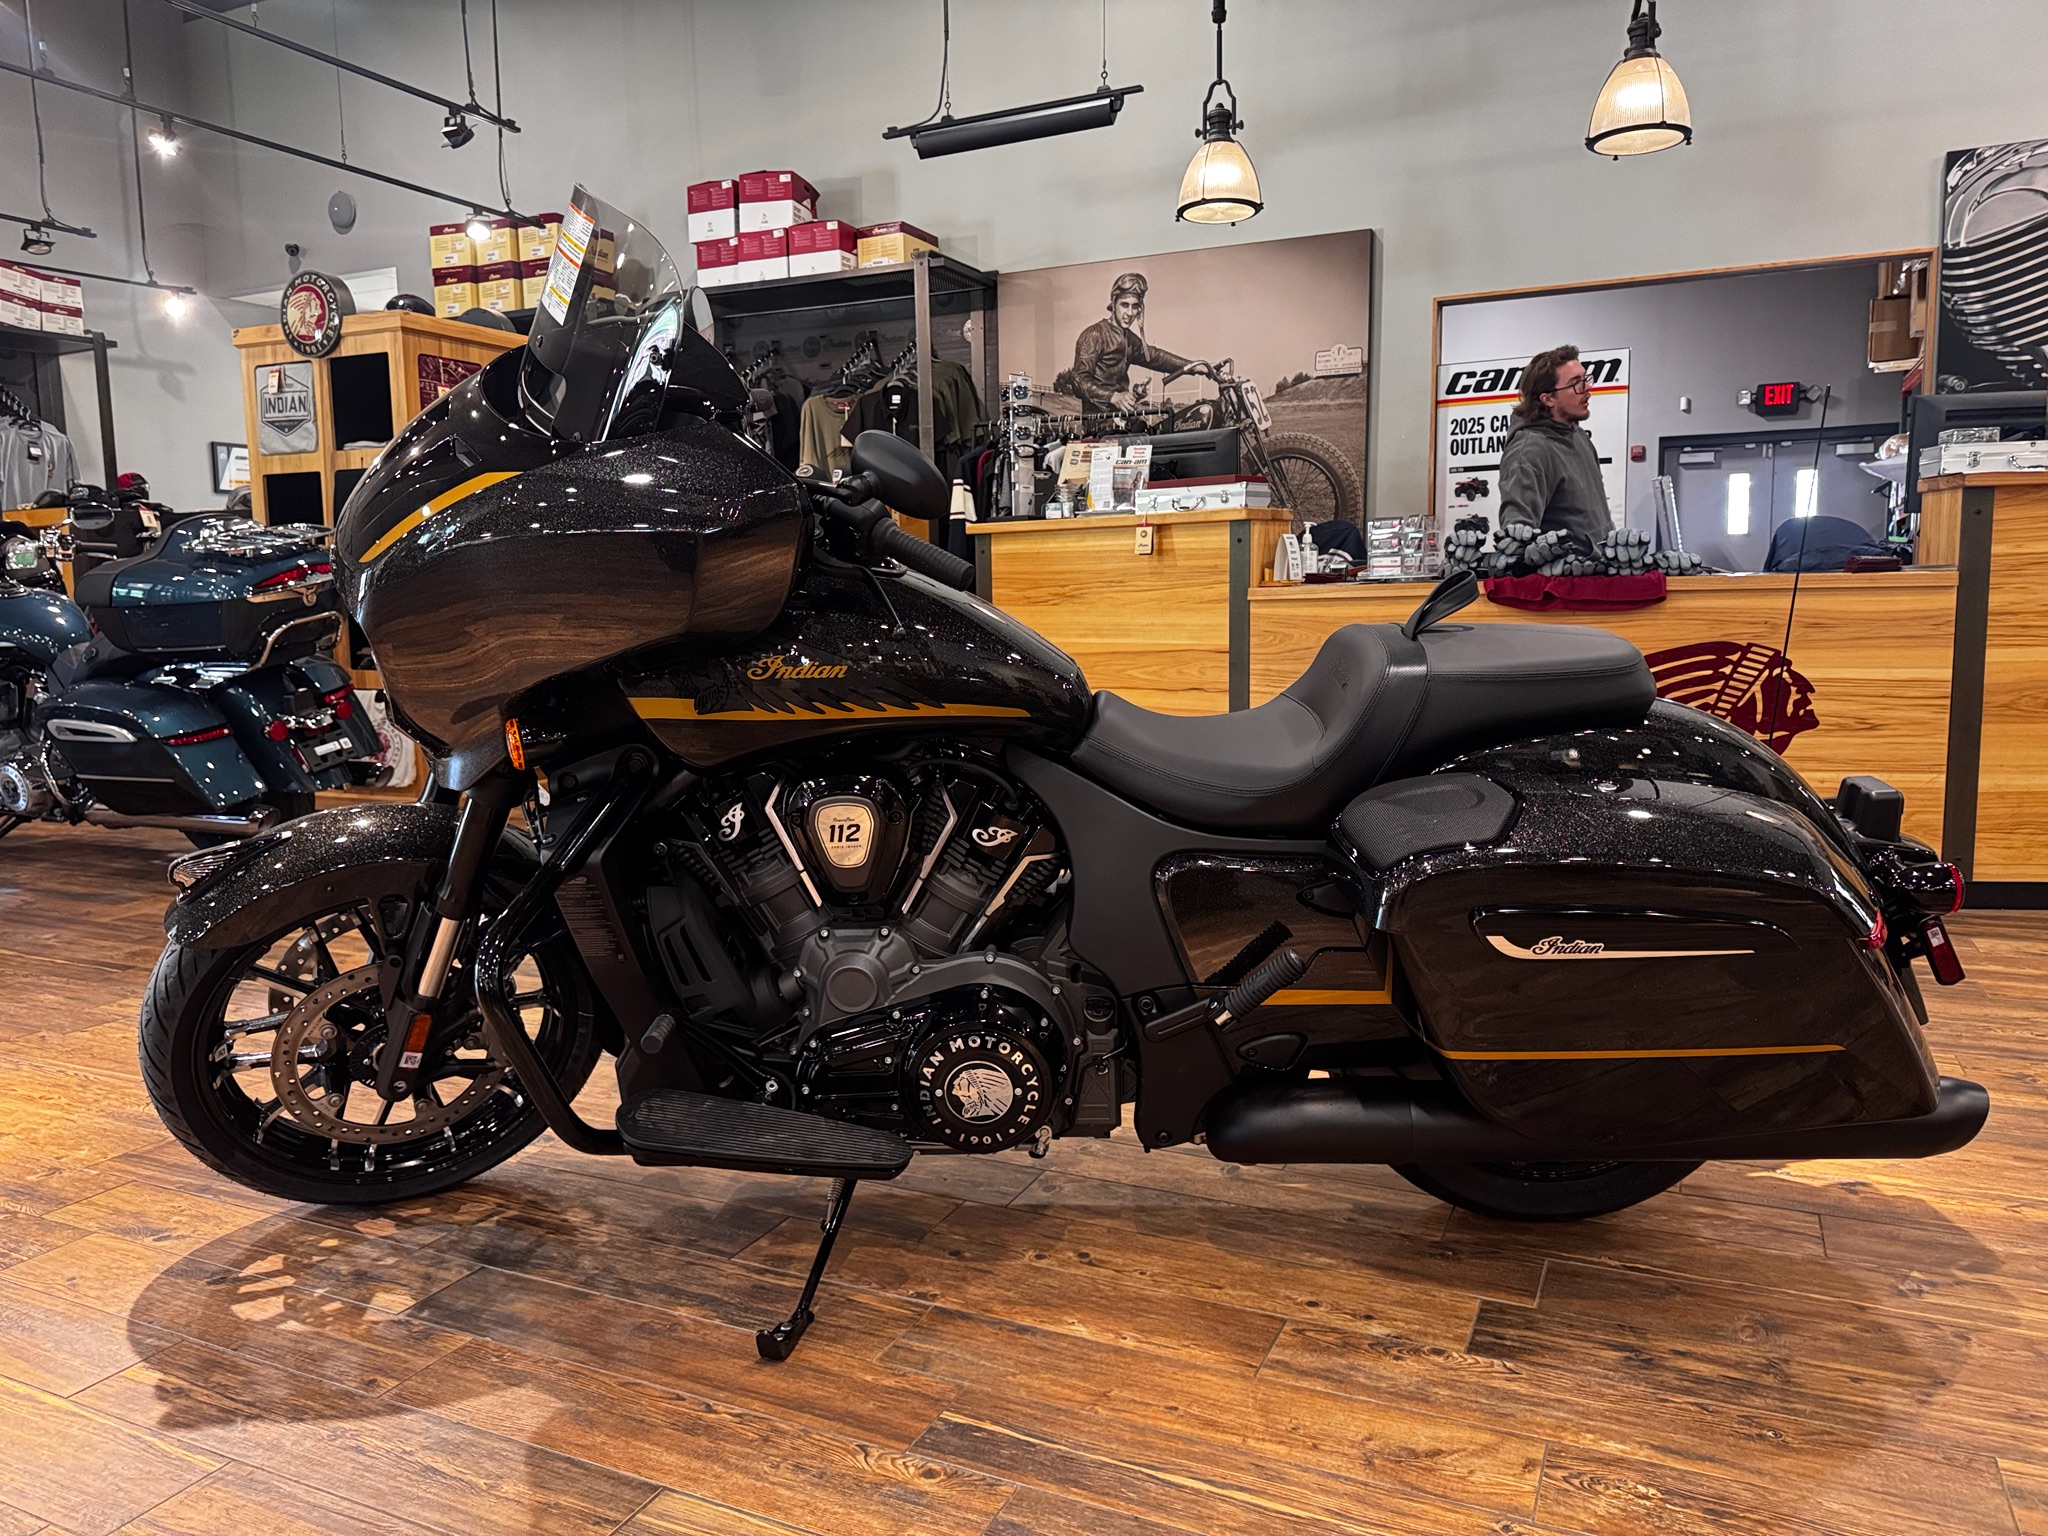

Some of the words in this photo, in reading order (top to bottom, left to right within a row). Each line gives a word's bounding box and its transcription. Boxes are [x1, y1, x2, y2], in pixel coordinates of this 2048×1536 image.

[1764, 384, 1794, 405] EXIT
[265, 395, 307, 414] INDIAN
[1174, 419, 1201, 431] Indian
[1450, 417, 1485, 436] 2025
[747, 655, 848, 680] Indian
[829, 824, 861, 843] 112
[1531, 937, 1603, 955] Indian
[919, 1050, 945, 1125] INDIAN
[949, 1035, 1039, 1125] MOTORCYCLE
[959, 1133, 1003, 1145] 1901
